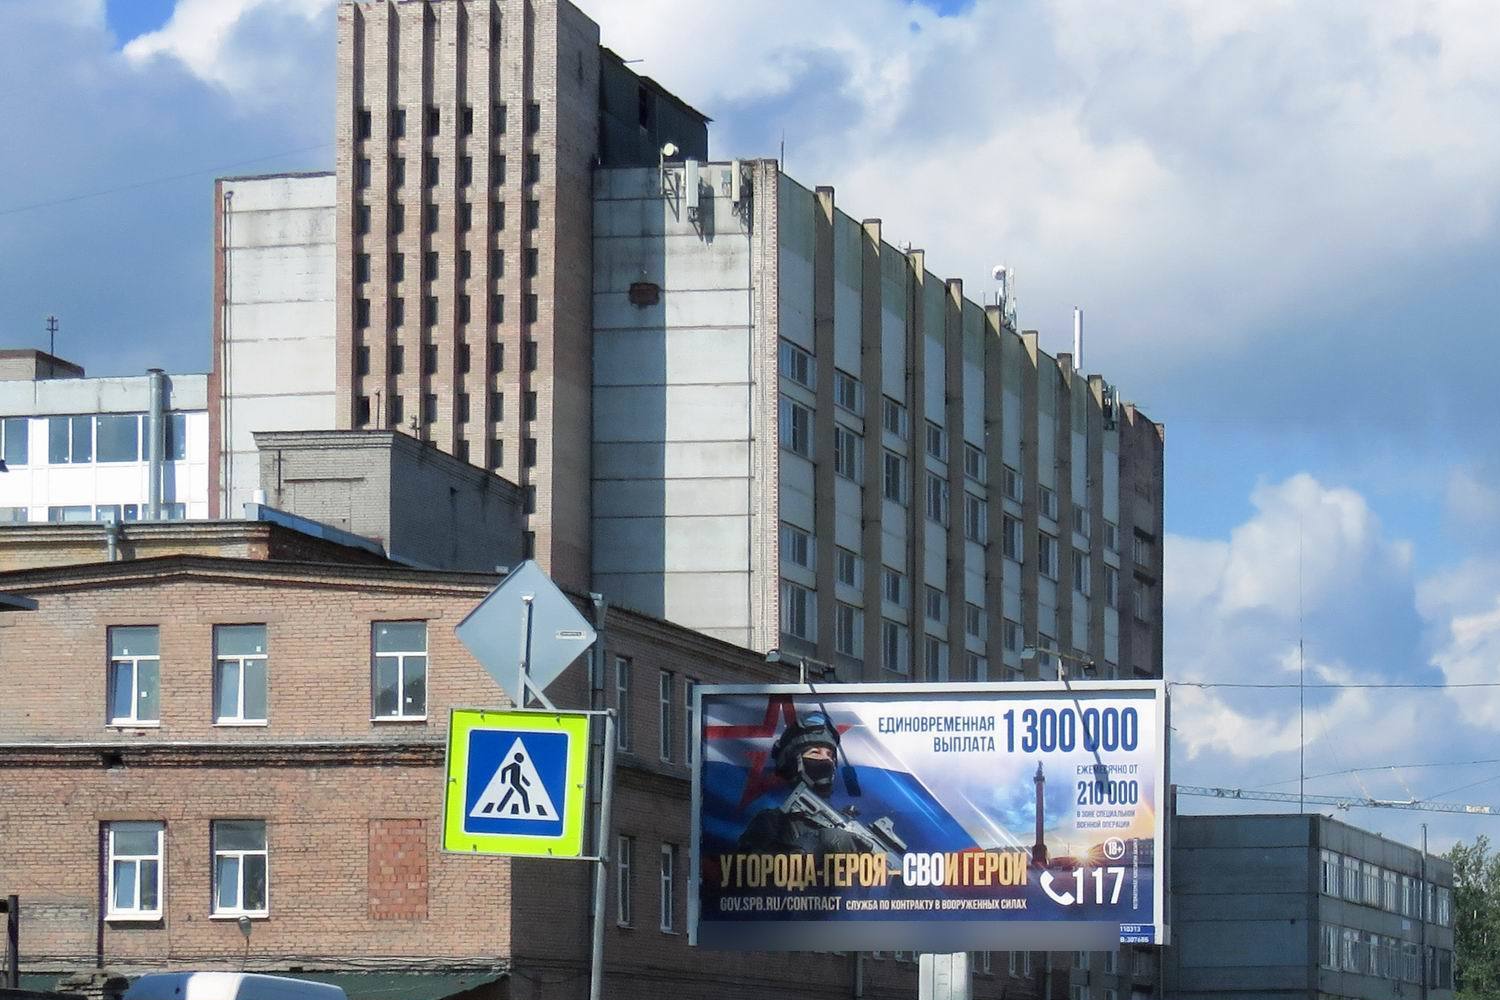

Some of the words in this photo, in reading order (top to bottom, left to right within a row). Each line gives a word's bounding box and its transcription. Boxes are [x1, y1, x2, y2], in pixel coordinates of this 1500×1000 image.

[878, 716, 996, 734] ЕДИНОВРЕМЕННАЯ
[933, 736, 996, 753] ВЫПЛАТА
[1129, 764, 1138, 774] ОТ
[1108, 842, 1123, 855] 18+
[720, 853, 732, 887] У
[736, 852, 887, 891] ГОРОДА-ГЕРОЯ
[902, 852, 958, 886] СВОИ
[963, 852, 1027, 886] ГЕРОИ
[1072, 867, 1125, 904] 117
[720, 896, 842, 912] GOV.SPB.RU/CONTRACT
[846, 900, 878, 911] СЛУЖБА
[880, 900, 889, 910] ПО
[891, 899, 933, 910] КОНТРАКТУ
[935, 900, 940, 910] В
[942, 899, 1000, 910] ВООРУЖЕННЫХ
[1001, 899, 1027, 910] СИЛАХ
